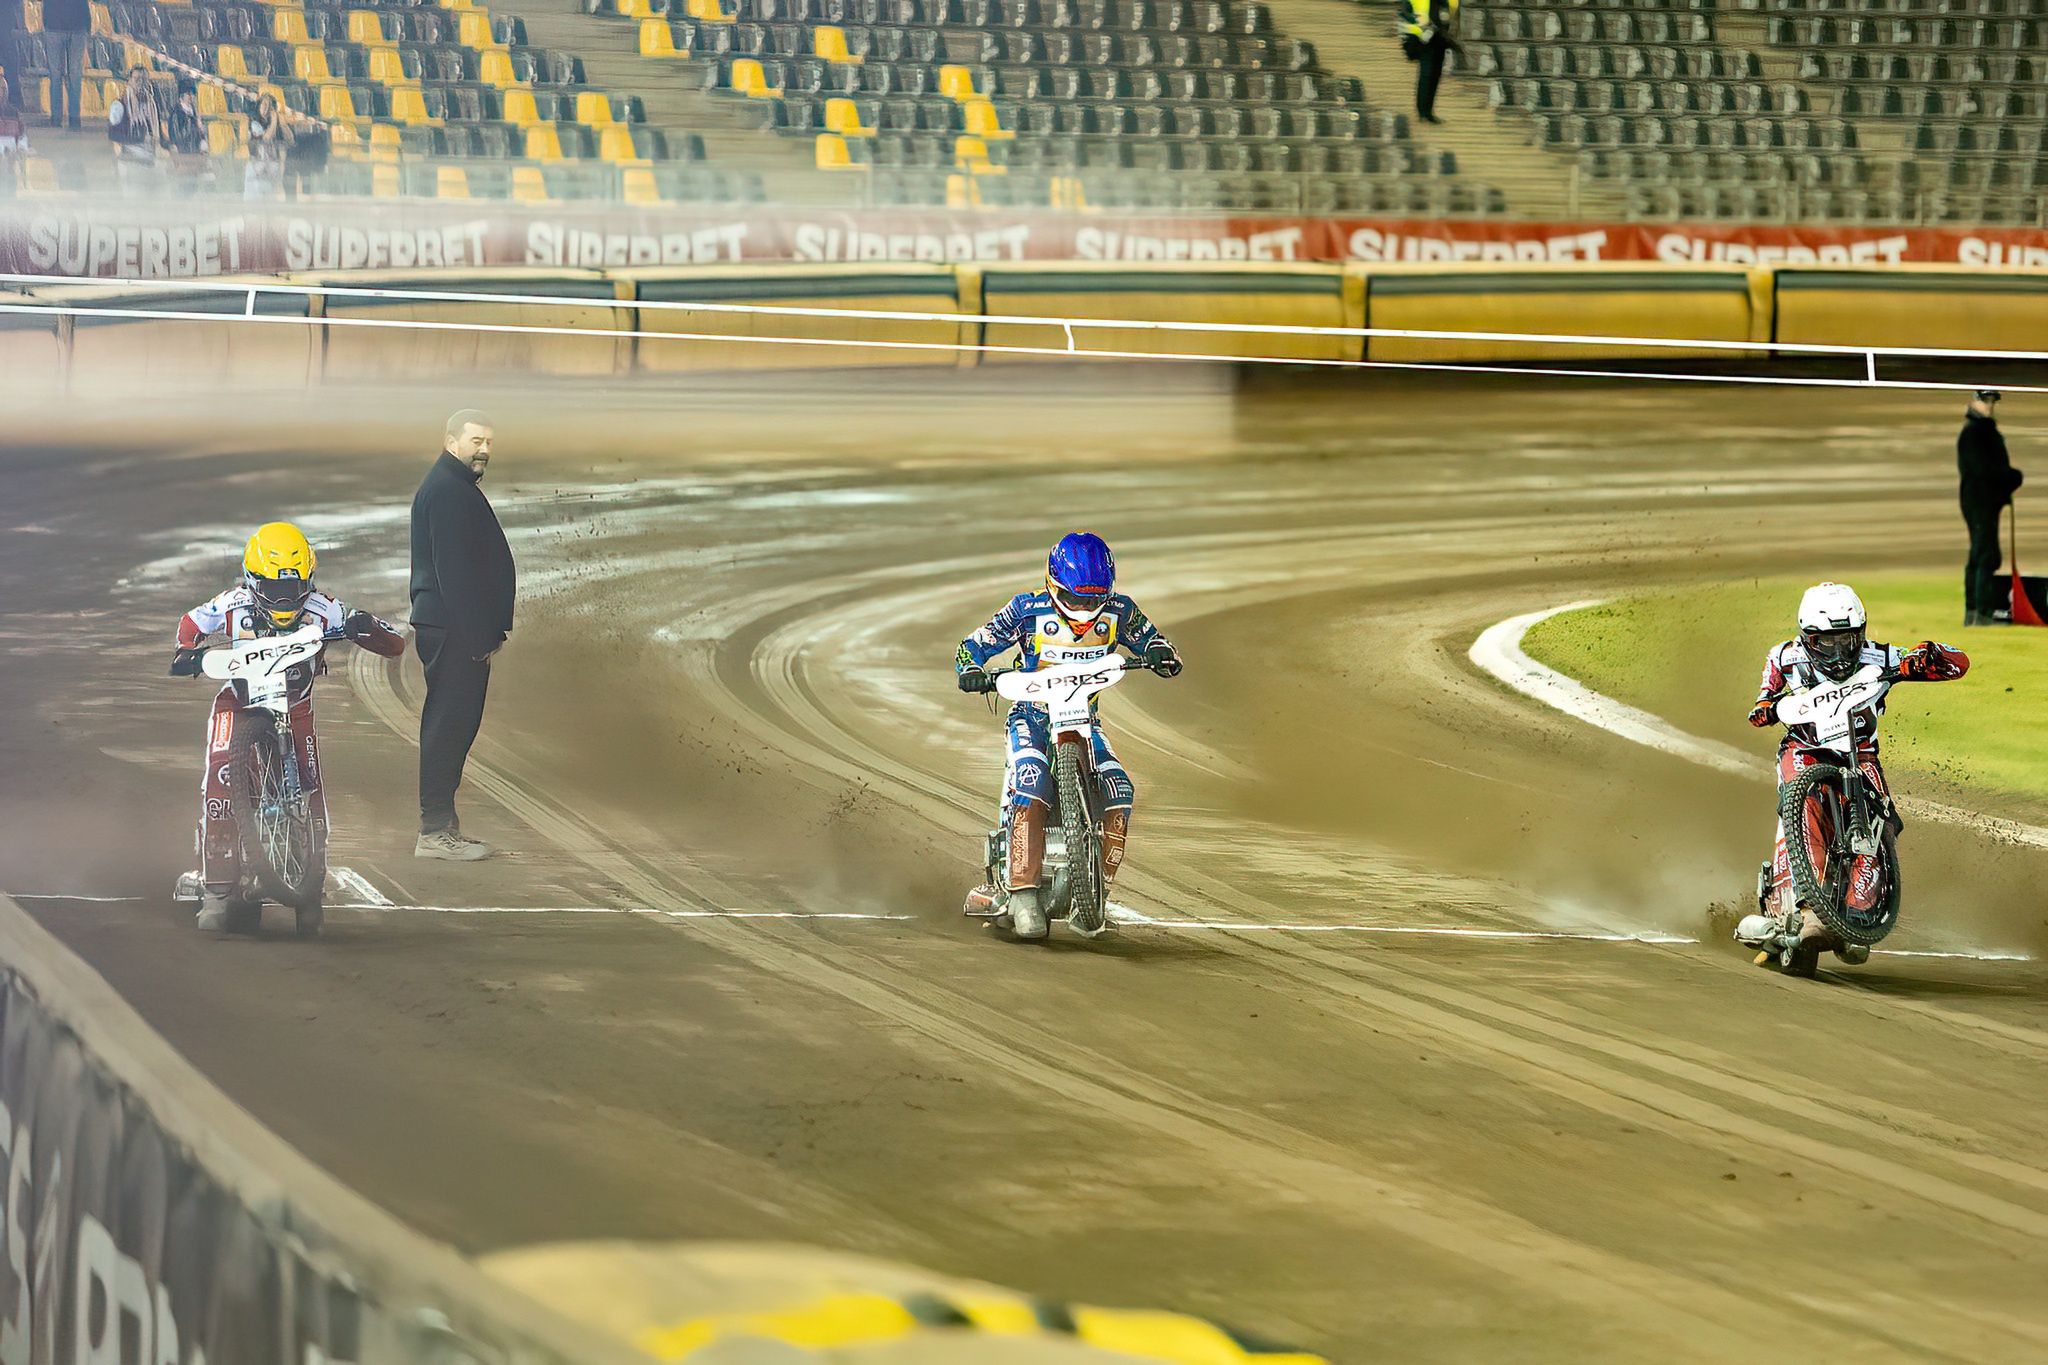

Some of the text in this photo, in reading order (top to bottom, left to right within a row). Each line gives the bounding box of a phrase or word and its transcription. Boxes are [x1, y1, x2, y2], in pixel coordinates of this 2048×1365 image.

[29, 215, 245, 279] SUPERBET
[286, 219, 488, 270] SUPERBET
[245, 642, 306, 666] PRES
[1061, 649, 1106, 660] PRES
[1047, 672, 1109, 690] PRES
[1813, 682, 1867, 708] PRES
